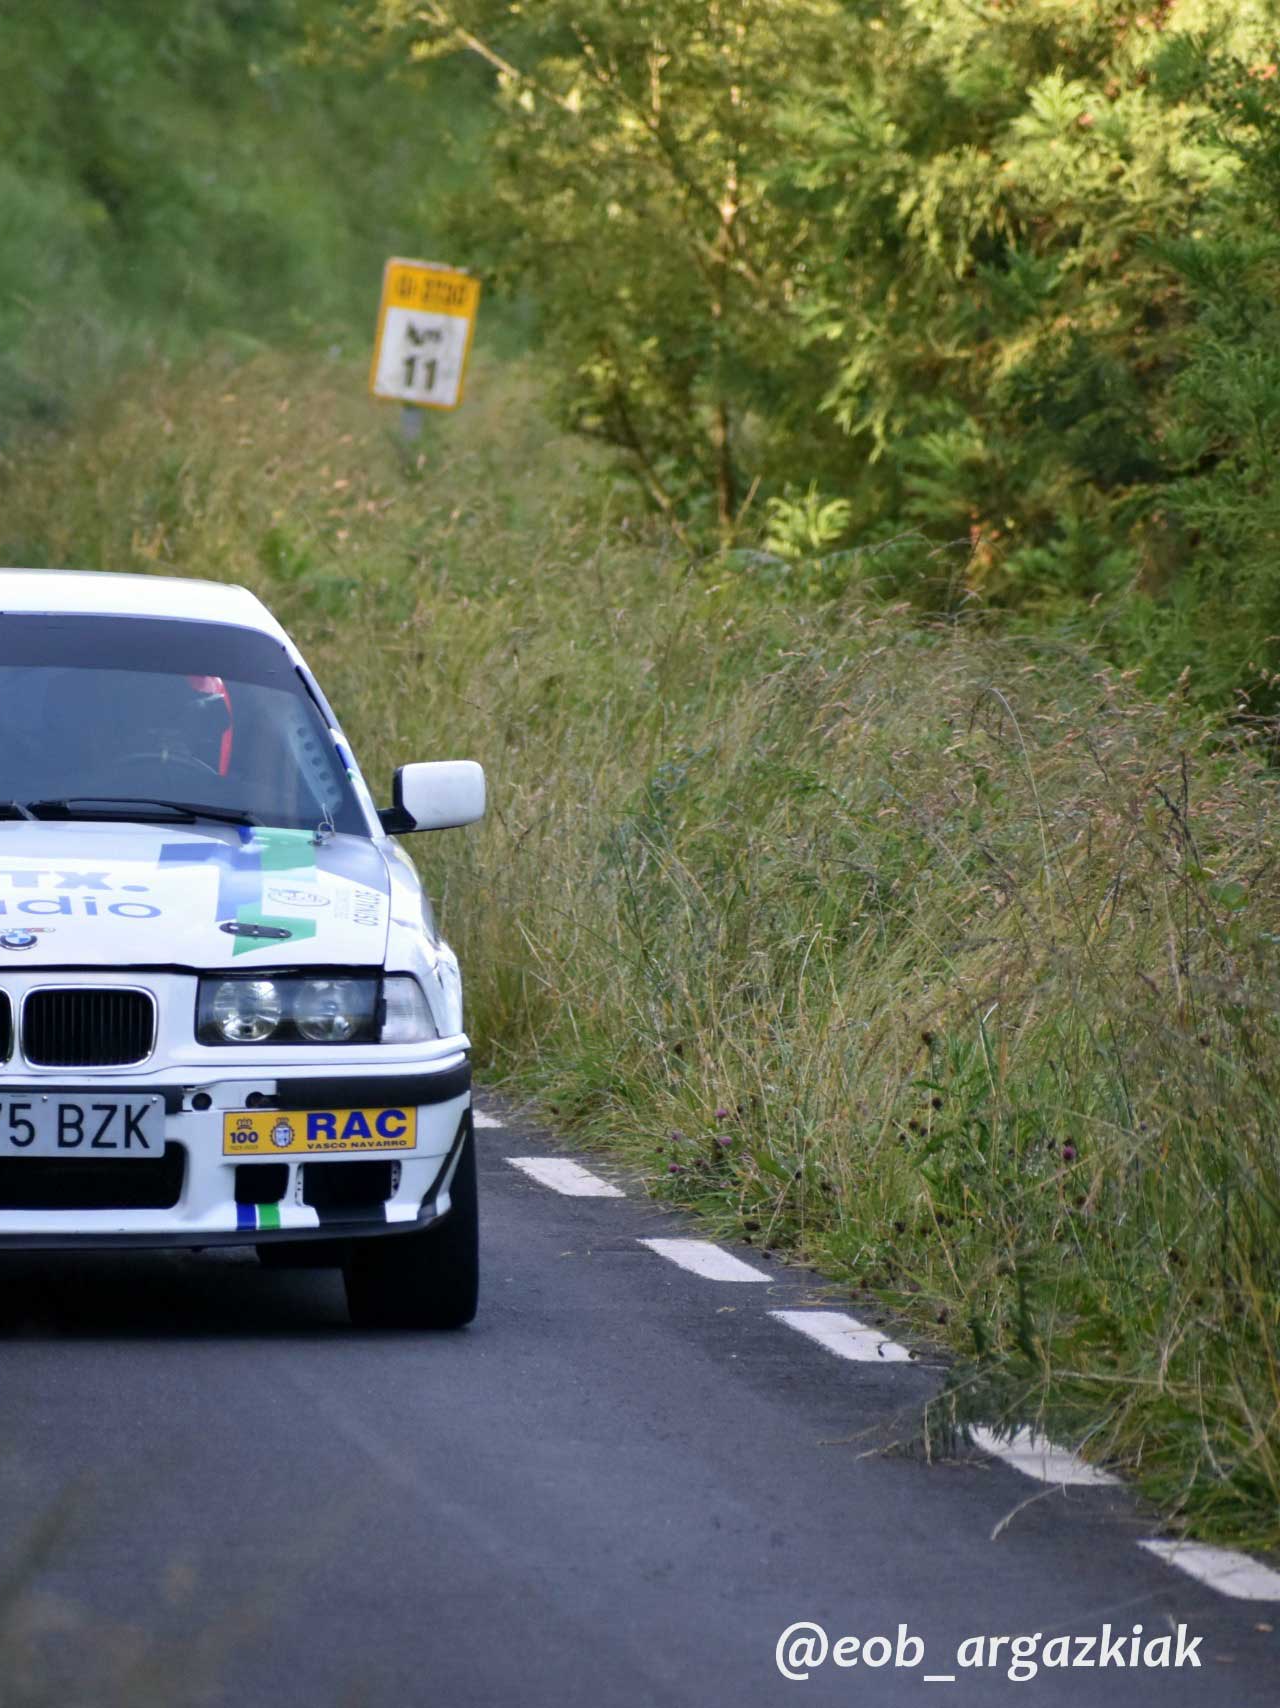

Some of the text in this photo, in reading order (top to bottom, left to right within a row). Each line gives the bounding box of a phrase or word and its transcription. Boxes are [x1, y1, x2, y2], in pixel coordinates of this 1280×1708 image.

[403, 354, 437, 392] 11
[58, 1103, 151, 1149] BZK
[229, 1131, 259, 1144] 100
[306, 1109, 408, 1141] RAC
[306, 1140, 408, 1150] VASCO NAVARRO
